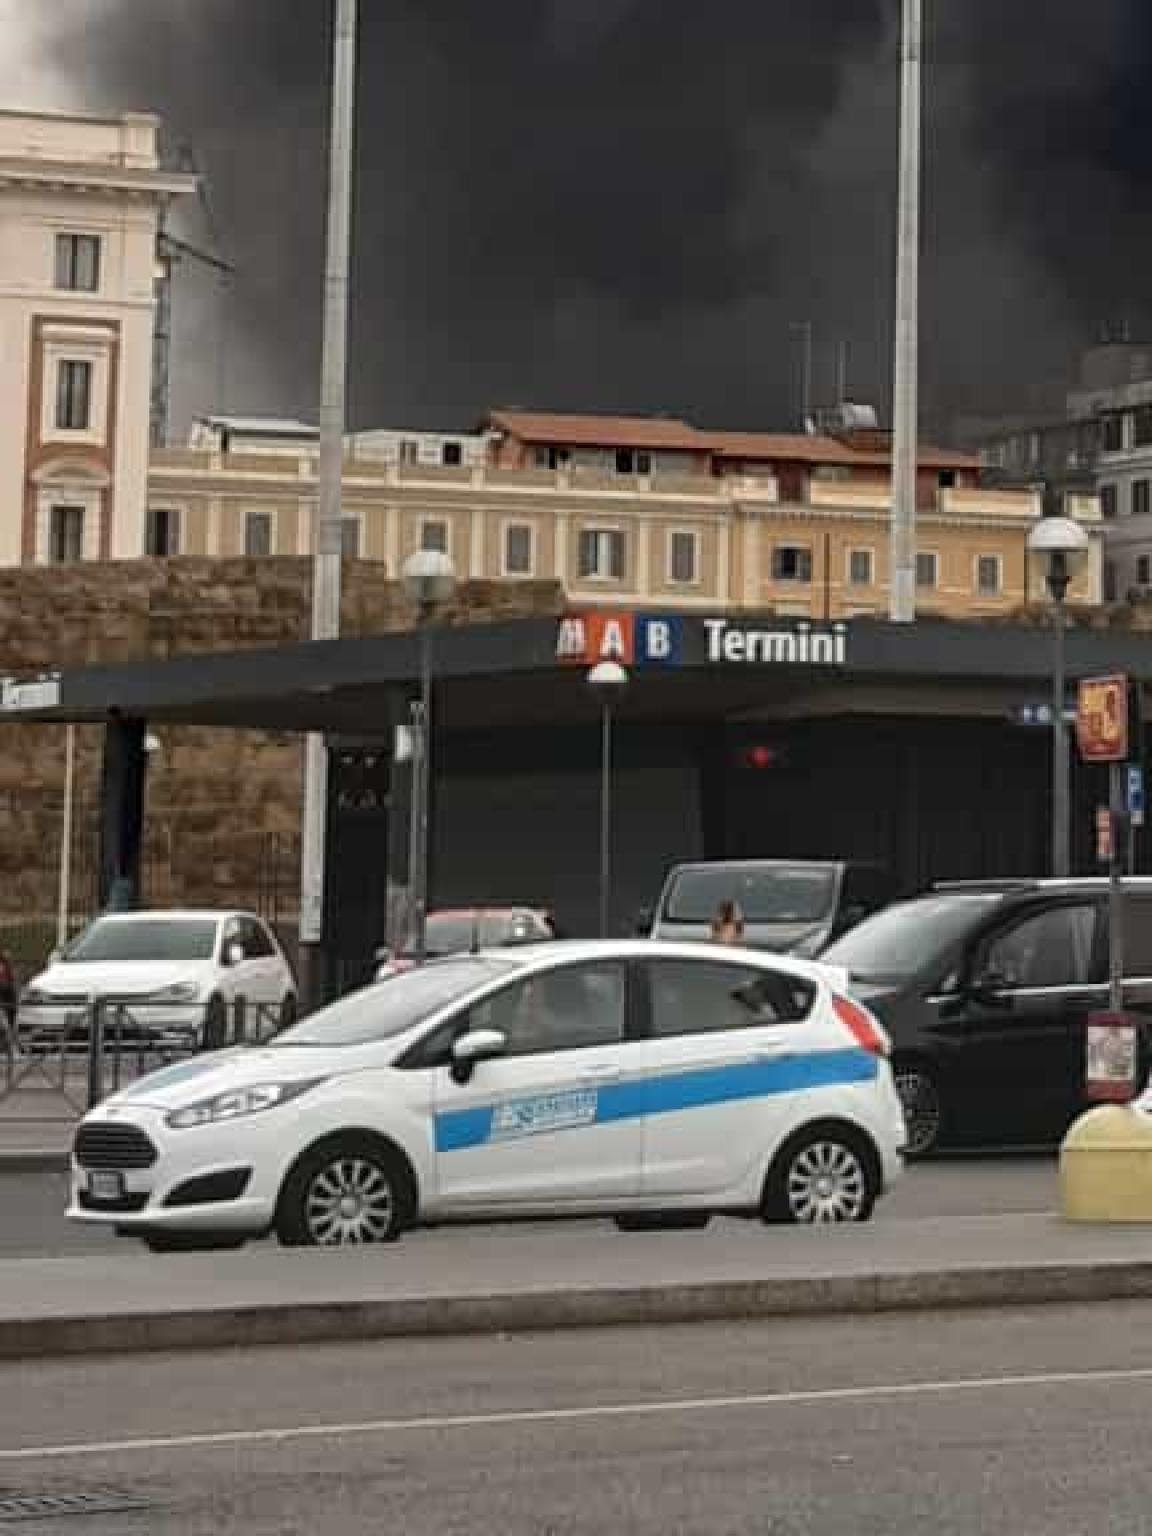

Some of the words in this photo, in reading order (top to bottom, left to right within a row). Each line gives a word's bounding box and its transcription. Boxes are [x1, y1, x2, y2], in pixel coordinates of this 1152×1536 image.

[600, 618, 624, 657] A
[646, 620, 671, 658] B
[703, 618, 846, 662] Termini
